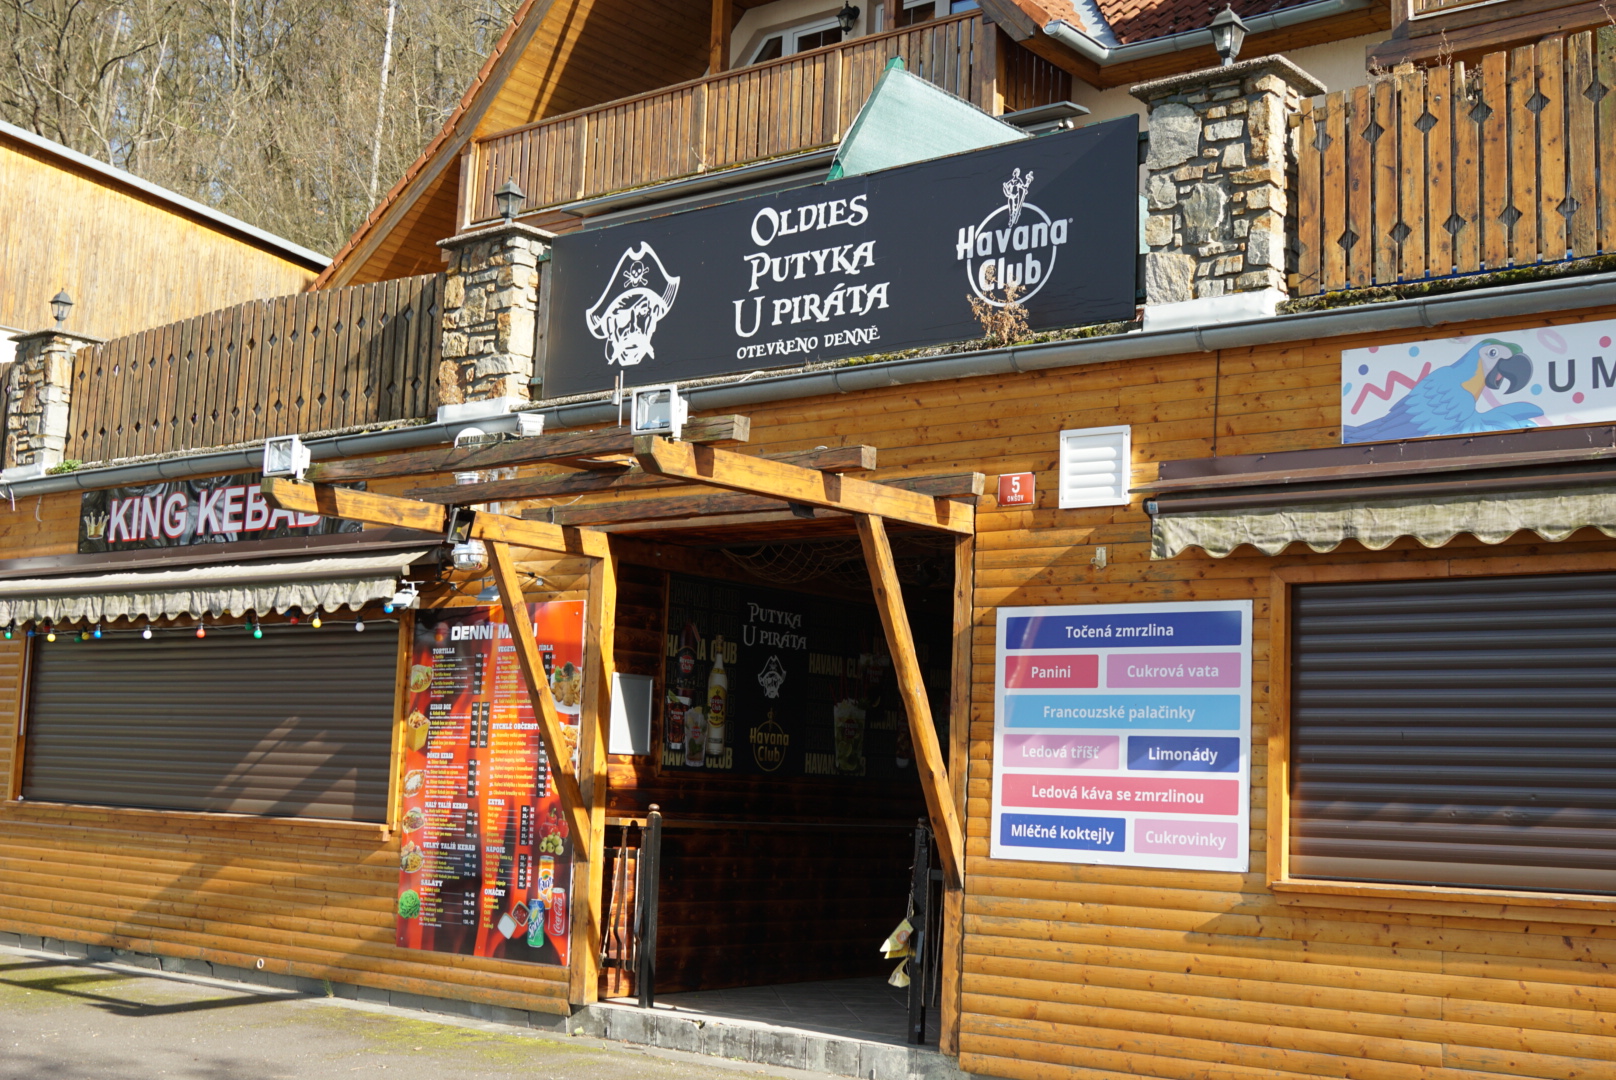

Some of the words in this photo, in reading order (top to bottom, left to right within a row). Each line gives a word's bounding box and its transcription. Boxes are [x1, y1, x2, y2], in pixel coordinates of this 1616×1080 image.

[751, 194, 868, 246] OLDIES
[956, 218, 1068, 260] Havana
[744, 240, 876, 292] PUTYKA
[978, 252, 1042, 291] Club
[732, 295, 765, 337] U
[771, 282, 890, 326] PIRÁTA
[736, 337, 818, 360] OTEVŘENO
[824, 325, 881, 347] DENNĚ
[1011, 476, 1021, 494] 5
[1007, 493, 1025, 502] ONŠOV
[108, 491, 189, 543] KING
[746, 601, 802, 629] PUTYKA
[451, 622, 495, 641] DENNÍ
[742, 624, 757, 647] U
[759, 630, 808, 650] PIRÁTA
[1066, 625, 1112, 639] Točená
[1115, 624, 1174, 638] zmrzlina
[710, 639, 738, 664] CUB
[1031, 666, 1071, 679] Panini
[1127, 664, 1184, 678] Cukrová
[1188, 665, 1219, 677] vata
[1043, 705, 1125, 719] Francouzské
[1129, 705, 1195, 722] palačinky
[492, 722, 512, 730] RYCHLÉ
[749, 727, 789, 746] Havana
[757, 746, 781, 762] Club
[1022, 745, 1067, 758] Ledová
[1070, 745, 1100, 759] tříšť
[1148, 747, 1218, 765] Limonády
[1031, 785, 1077, 799] Ledová
[1081, 786, 1113, 800] káva
[1116, 789, 1131, 801] se
[1134, 788, 1204, 804] zmrzlinou
[1011, 823, 1057, 839] Mléčné
[1060, 825, 1114, 845] koktejly
[1145, 830, 1226, 850] Cukrovinky
[423, 841, 440, 849] VELKÝ
[440, 842, 456, 850] TALÍŘ
[485, 845, 506, 853] NÁPOJE
[420, 879, 443, 887] SALÁTY
[484, 888, 506, 896] OMÁČKY
